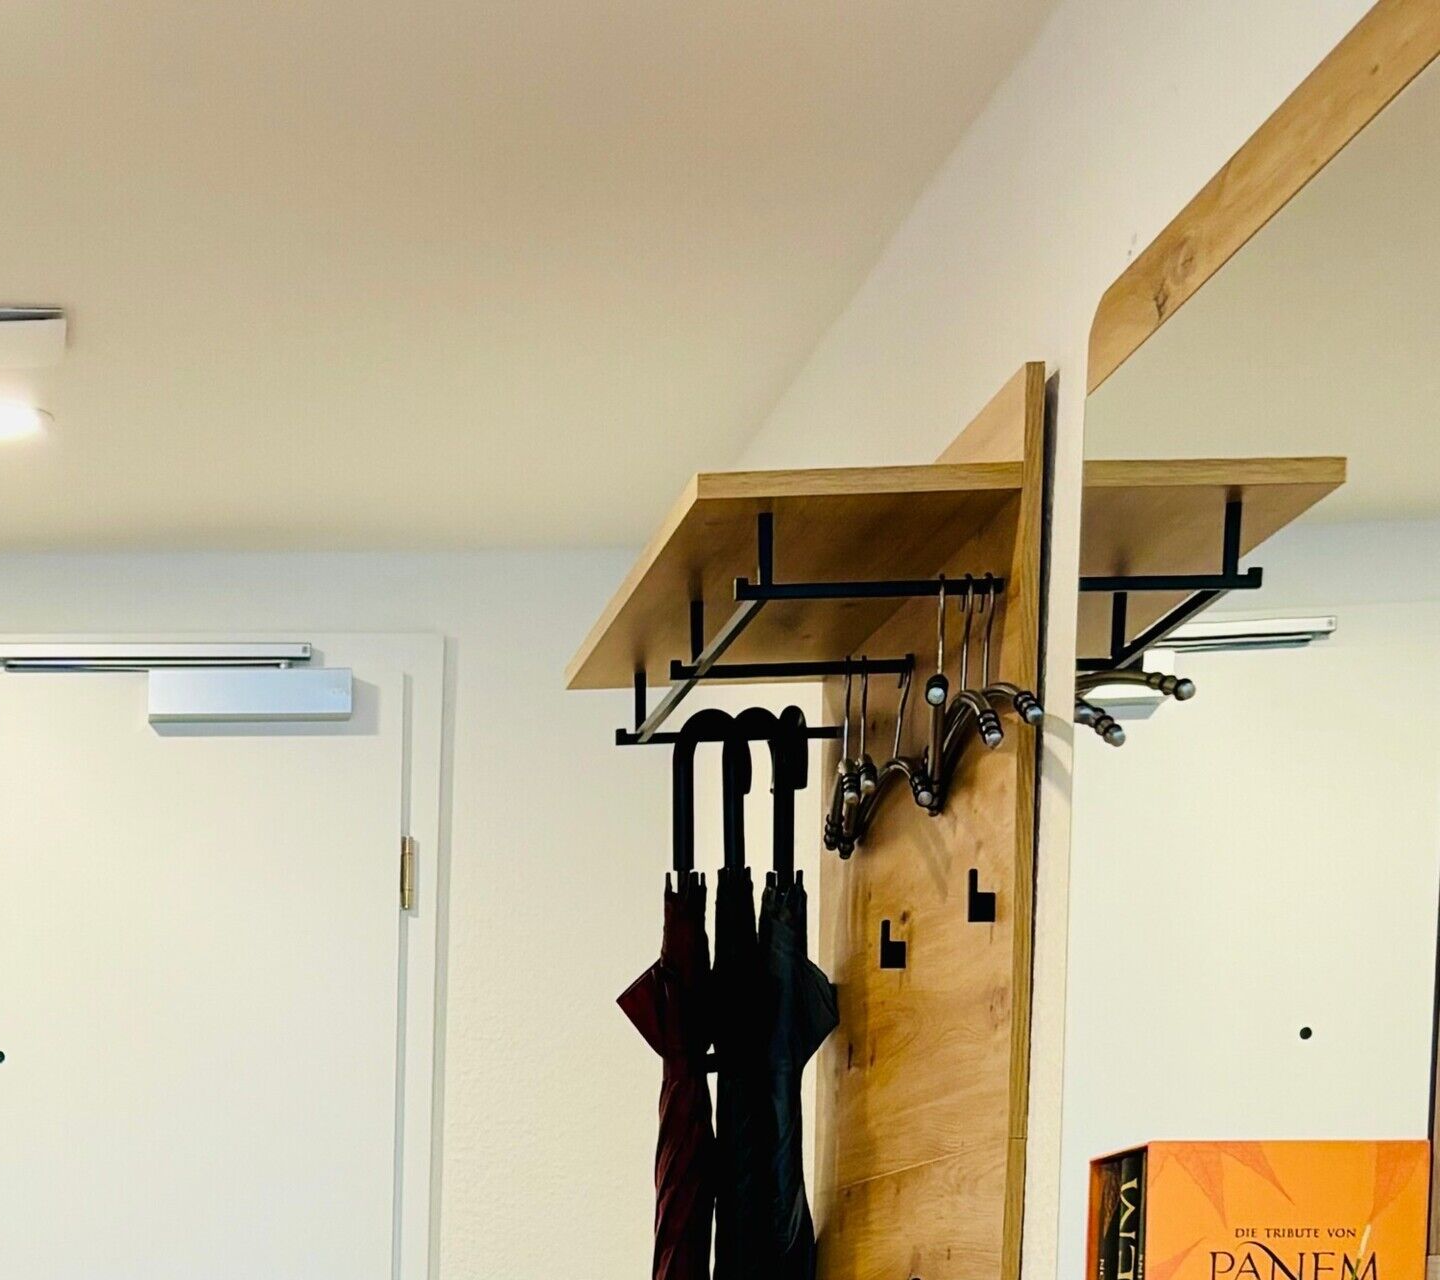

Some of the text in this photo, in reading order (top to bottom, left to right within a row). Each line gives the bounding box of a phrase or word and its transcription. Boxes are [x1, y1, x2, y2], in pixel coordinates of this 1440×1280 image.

[1235, 1228, 1356, 1238] DIE TRIBUTE VON
